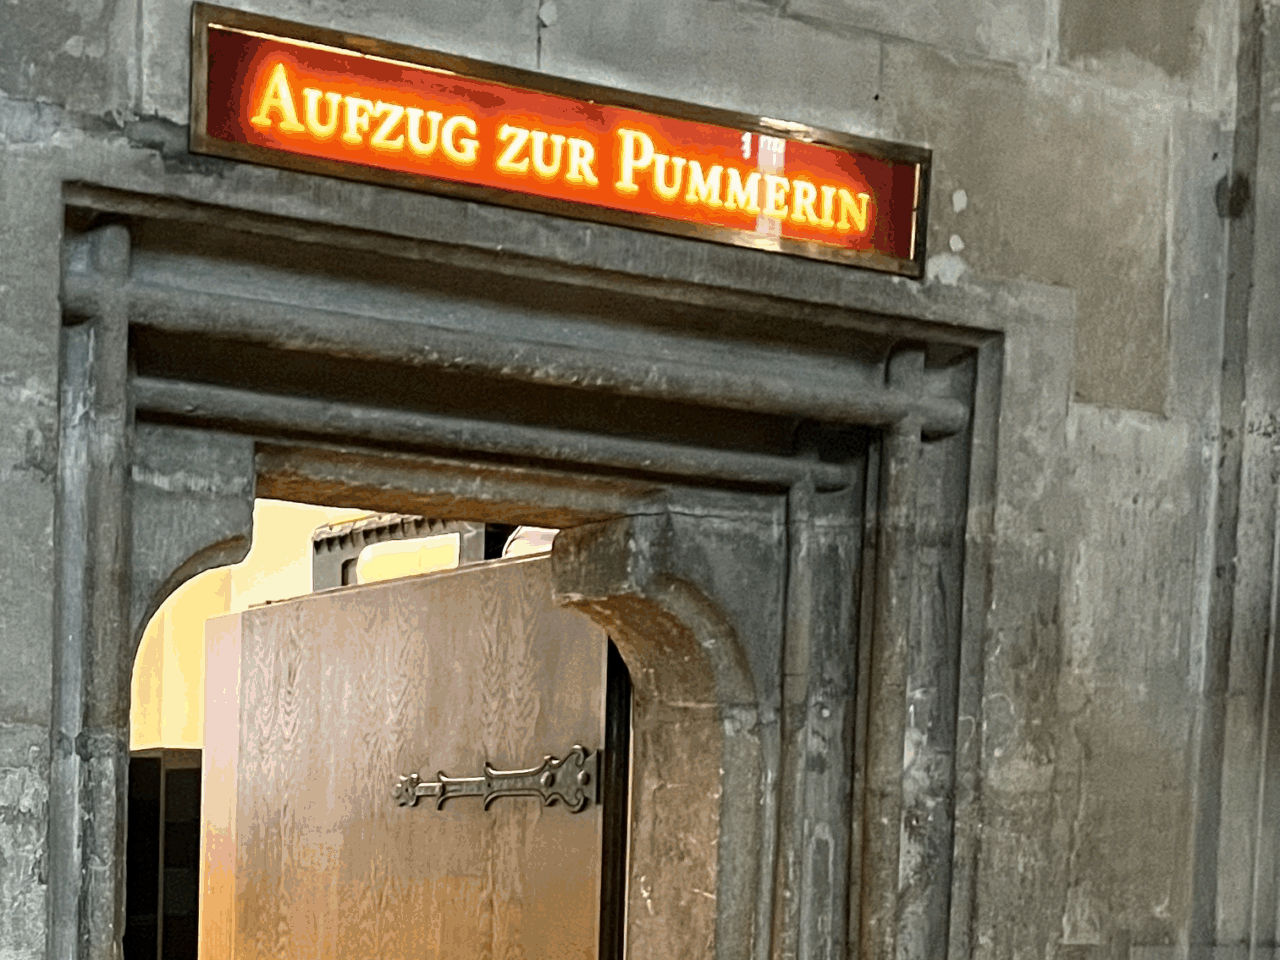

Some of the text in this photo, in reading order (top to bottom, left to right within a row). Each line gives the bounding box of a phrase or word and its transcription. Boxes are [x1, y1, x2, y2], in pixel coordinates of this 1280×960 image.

[251, 61, 870, 232] AUFZUG ZUR PUMMERIN
